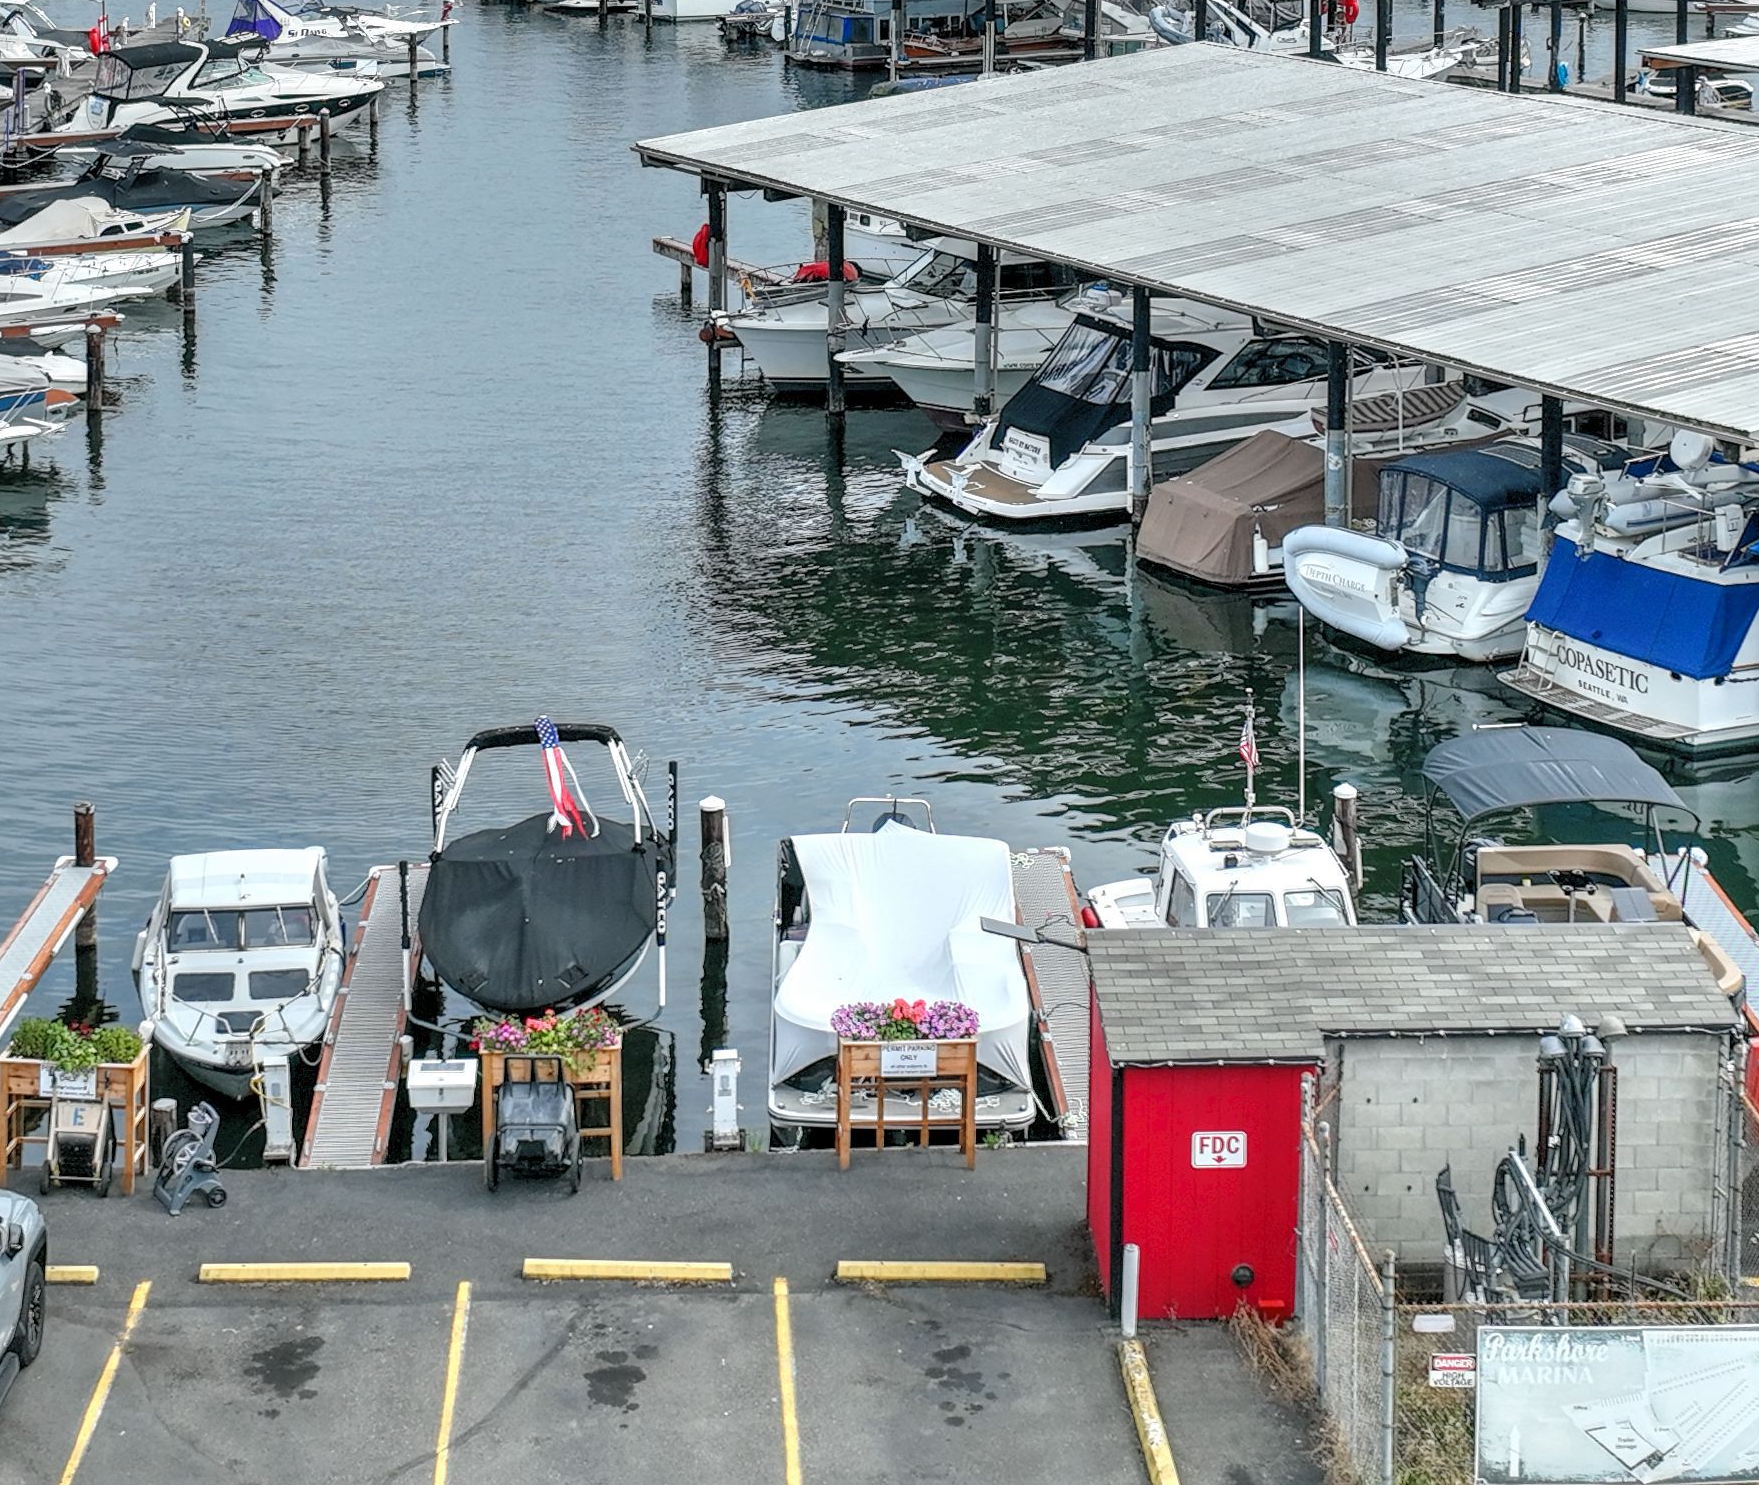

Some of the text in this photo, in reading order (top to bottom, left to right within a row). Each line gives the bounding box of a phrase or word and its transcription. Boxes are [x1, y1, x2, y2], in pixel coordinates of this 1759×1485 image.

[1306, 565, 1366, 592] DEPTH CHARGE
[1557, 644, 1649, 694] COPASETIC
[657, 870, 667, 935] GATCO
[73, 1107, 86, 1126] E
[1199, 1136, 1240, 1155] FDC
[1483, 1332, 1609, 1363] Parkshore
[1434, 1357, 1474, 1369] DANGER
[1434, 1377, 1473, 1387] VOLTAGE
[1442, 1371, 1465, 1380] HIGH
[1498, 1366, 1594, 1385] MARINA
